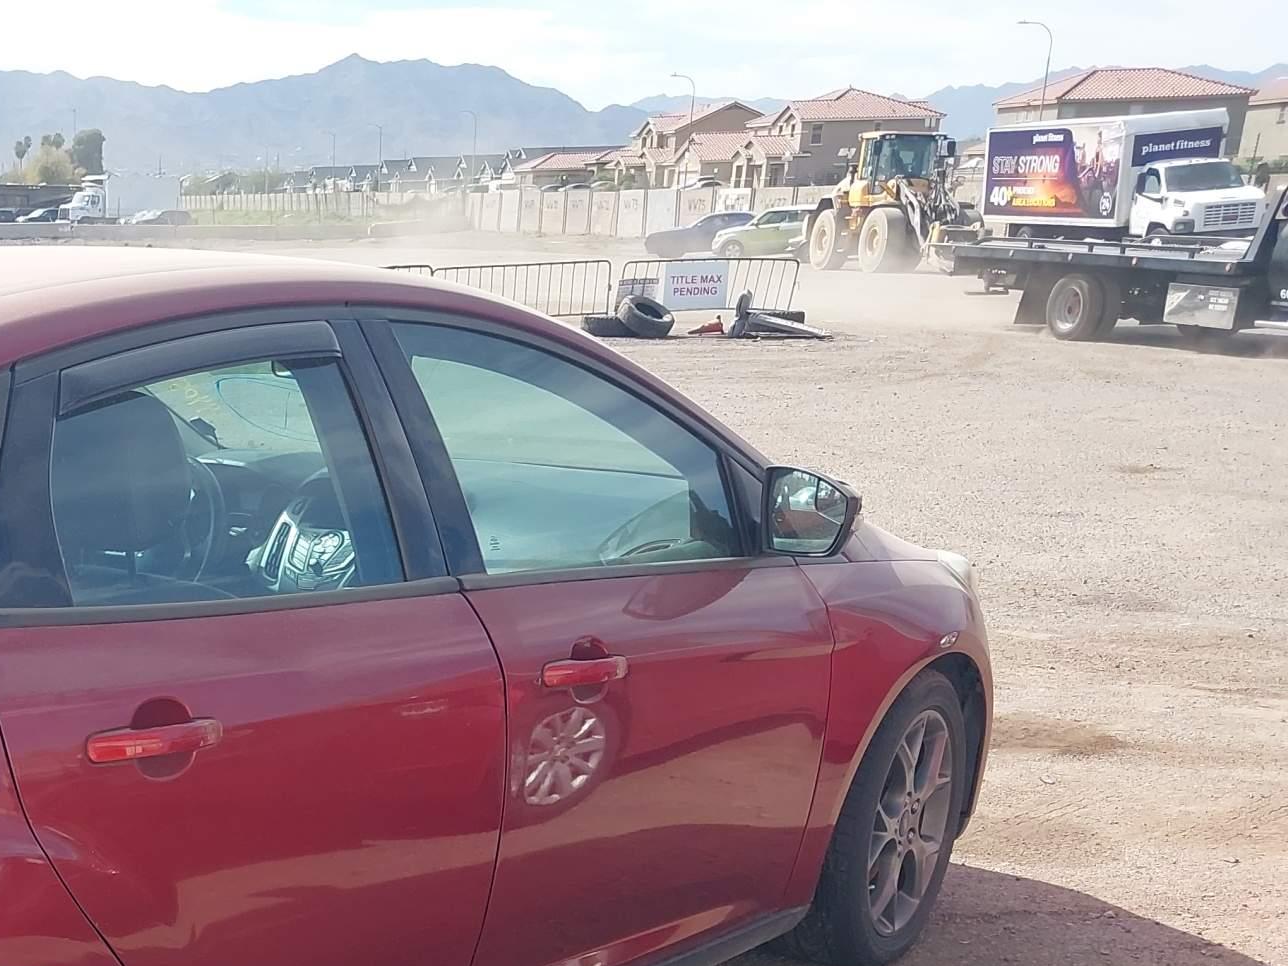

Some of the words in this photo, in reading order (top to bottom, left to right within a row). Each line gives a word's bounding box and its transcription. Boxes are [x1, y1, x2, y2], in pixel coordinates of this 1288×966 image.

[1141, 142, 1175, 156] planet
[1176, 139, 1212, 150] fitness
[992, 155, 1018, 174] STAY
[1018, 154, 1061, 174] STRONG
[671, 275, 697, 285] TITLE
[700, 274, 722, 284] MAX
[673, 286, 718, 297] PENDING
